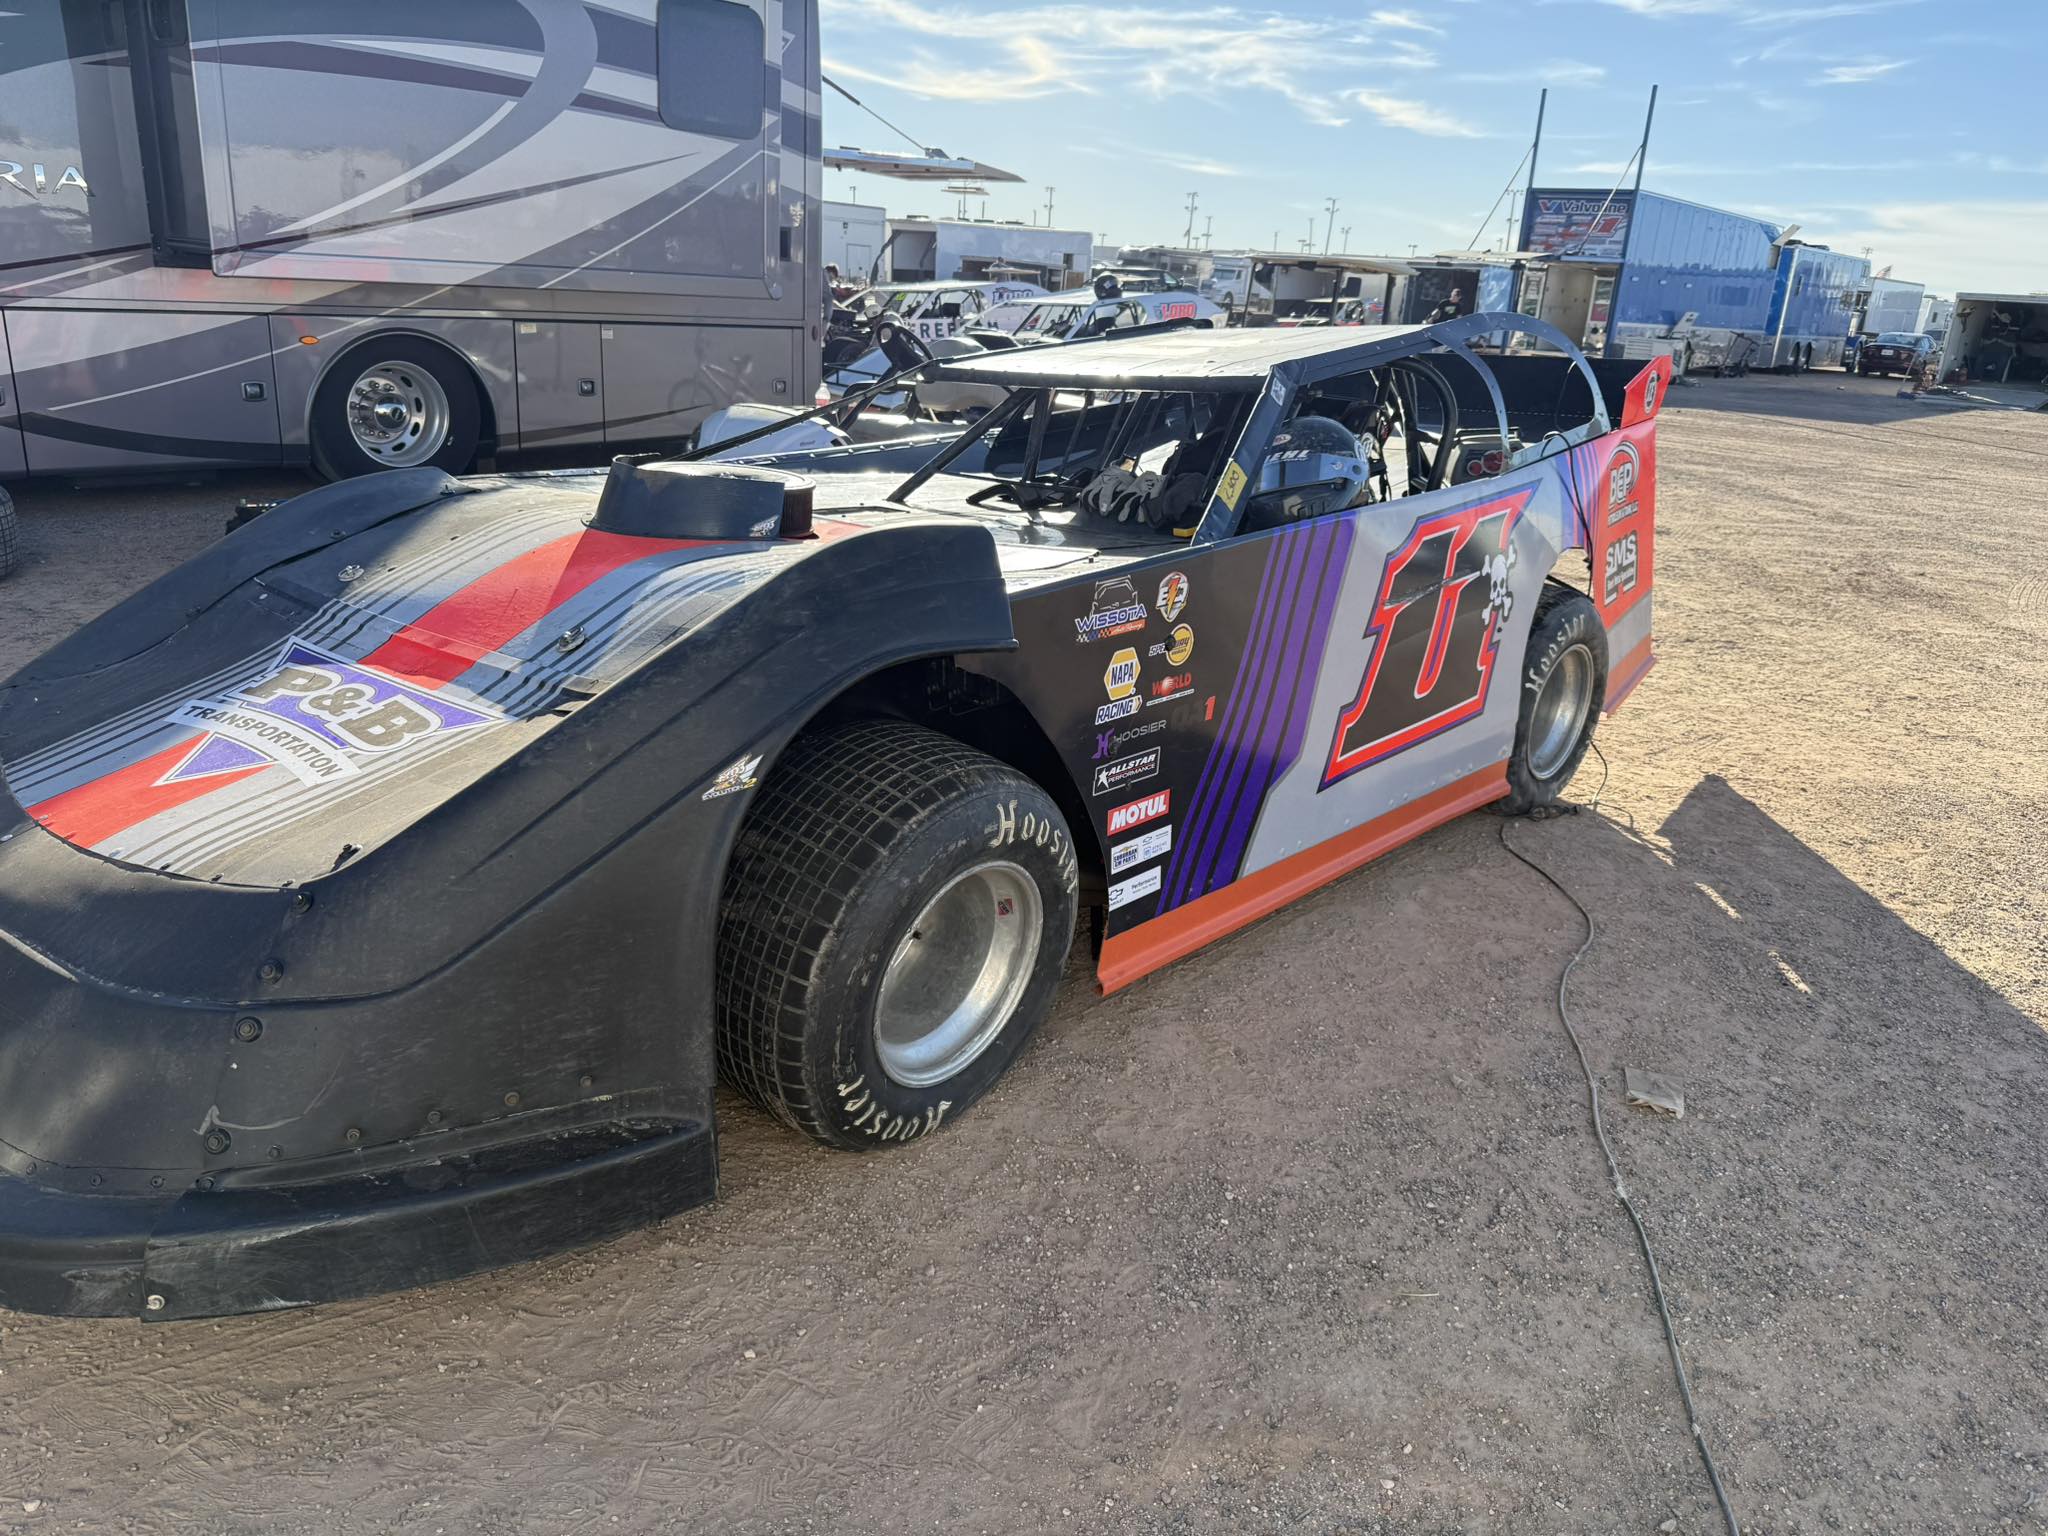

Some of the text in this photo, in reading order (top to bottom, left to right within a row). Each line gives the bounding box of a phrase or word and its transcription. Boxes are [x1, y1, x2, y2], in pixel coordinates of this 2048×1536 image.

[1605, 533, 1637, 575] SMS
[1075, 603, 1147, 632] WISSOTA
[1111, 661, 1135, 687] NAPA
[239, 666, 432, 748] P&B
[1095, 698, 1134, 725] RACING
[182, 704, 343, 778] TRANSPORTATION
[1108, 753, 1156, 776] ALLSTAR
[1108, 762, 1156, 783] PERFORMANCE
[1110, 794, 1166, 832] MOTUL
